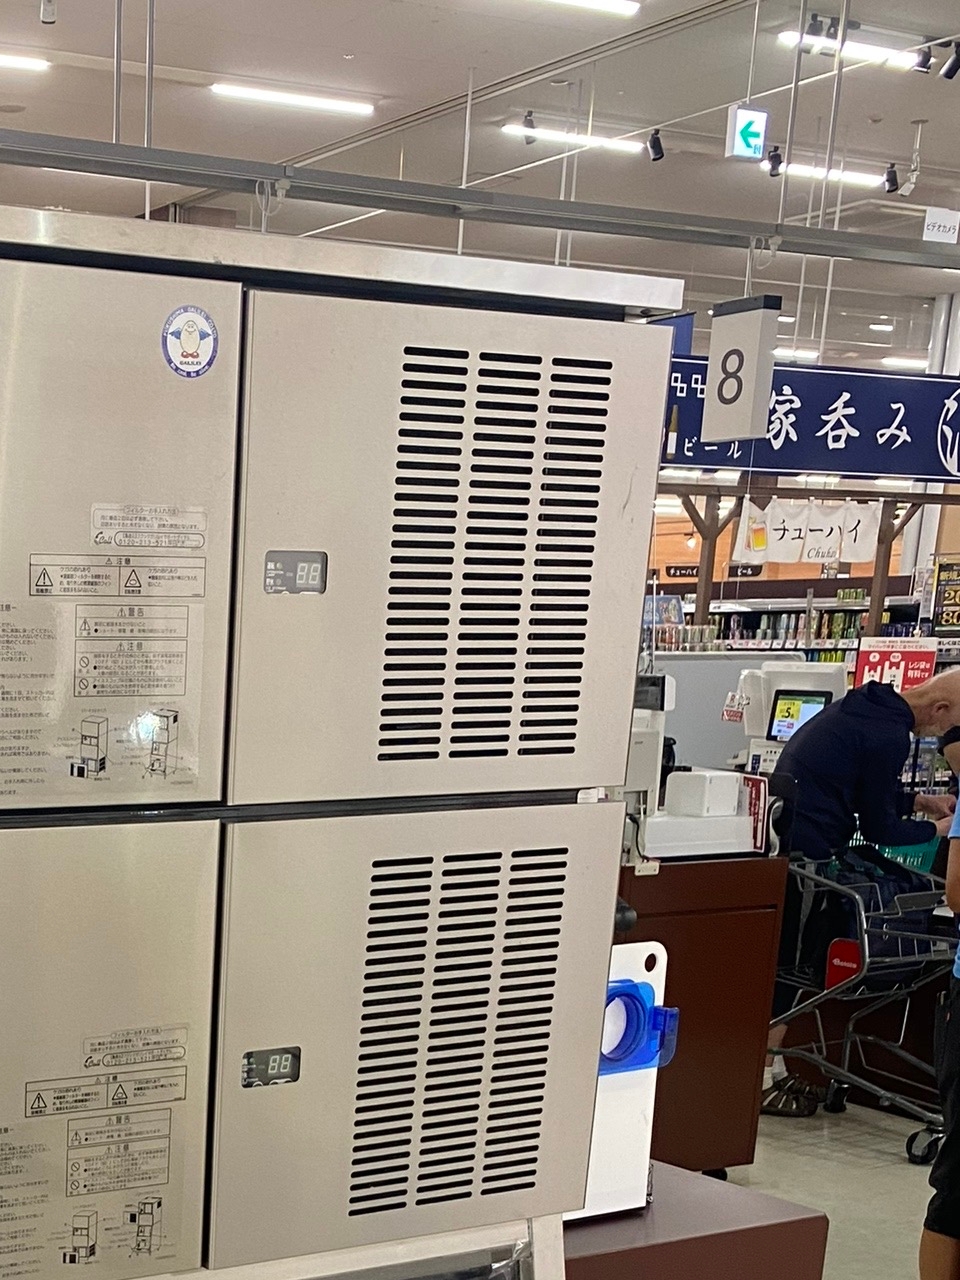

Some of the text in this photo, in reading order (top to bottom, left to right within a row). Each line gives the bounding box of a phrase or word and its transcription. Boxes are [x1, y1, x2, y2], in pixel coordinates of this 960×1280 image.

[716, 348, 745, 405] 8
[766, 384, 912, 450] 家呑み
[684, 436, 742, 460] ビール
[772, 518, 861, 544] チューハイ
[669, 567, 698, 575] チューハイ
[737, 567, 753, 575] ビール
